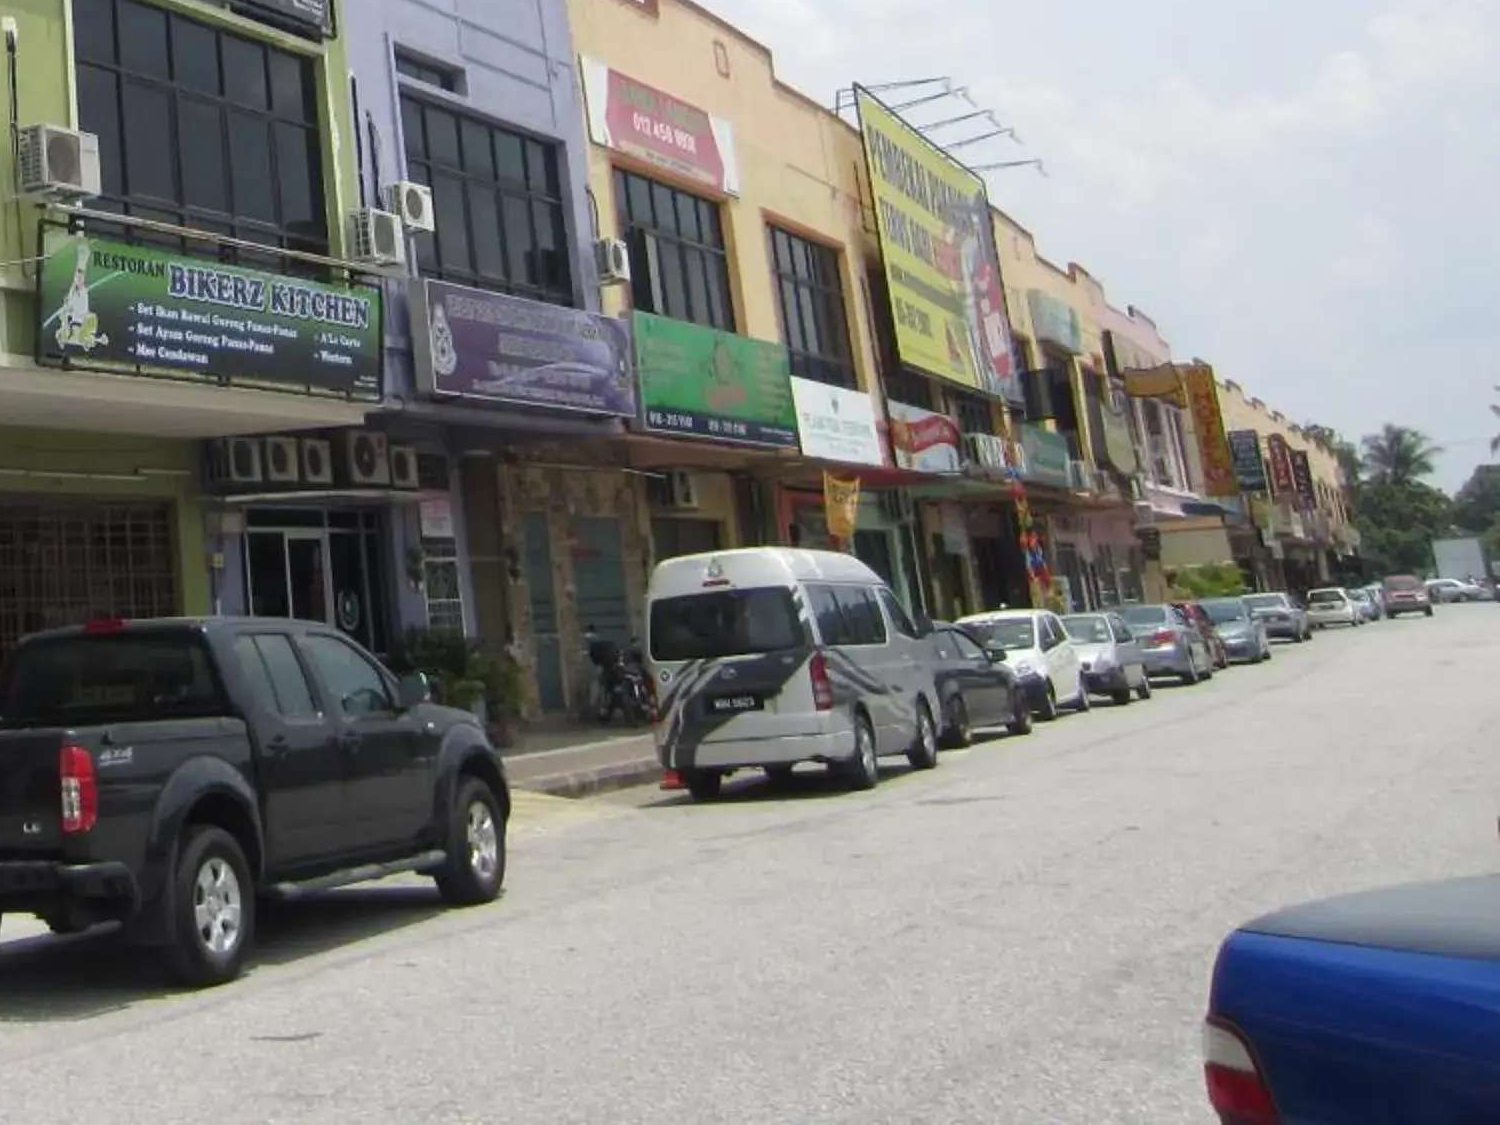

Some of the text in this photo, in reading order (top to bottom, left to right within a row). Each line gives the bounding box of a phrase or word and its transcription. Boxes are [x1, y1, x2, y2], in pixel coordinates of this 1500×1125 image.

[93, 251, 371, 328] RESTORAN BIKERZ KITCHEN
